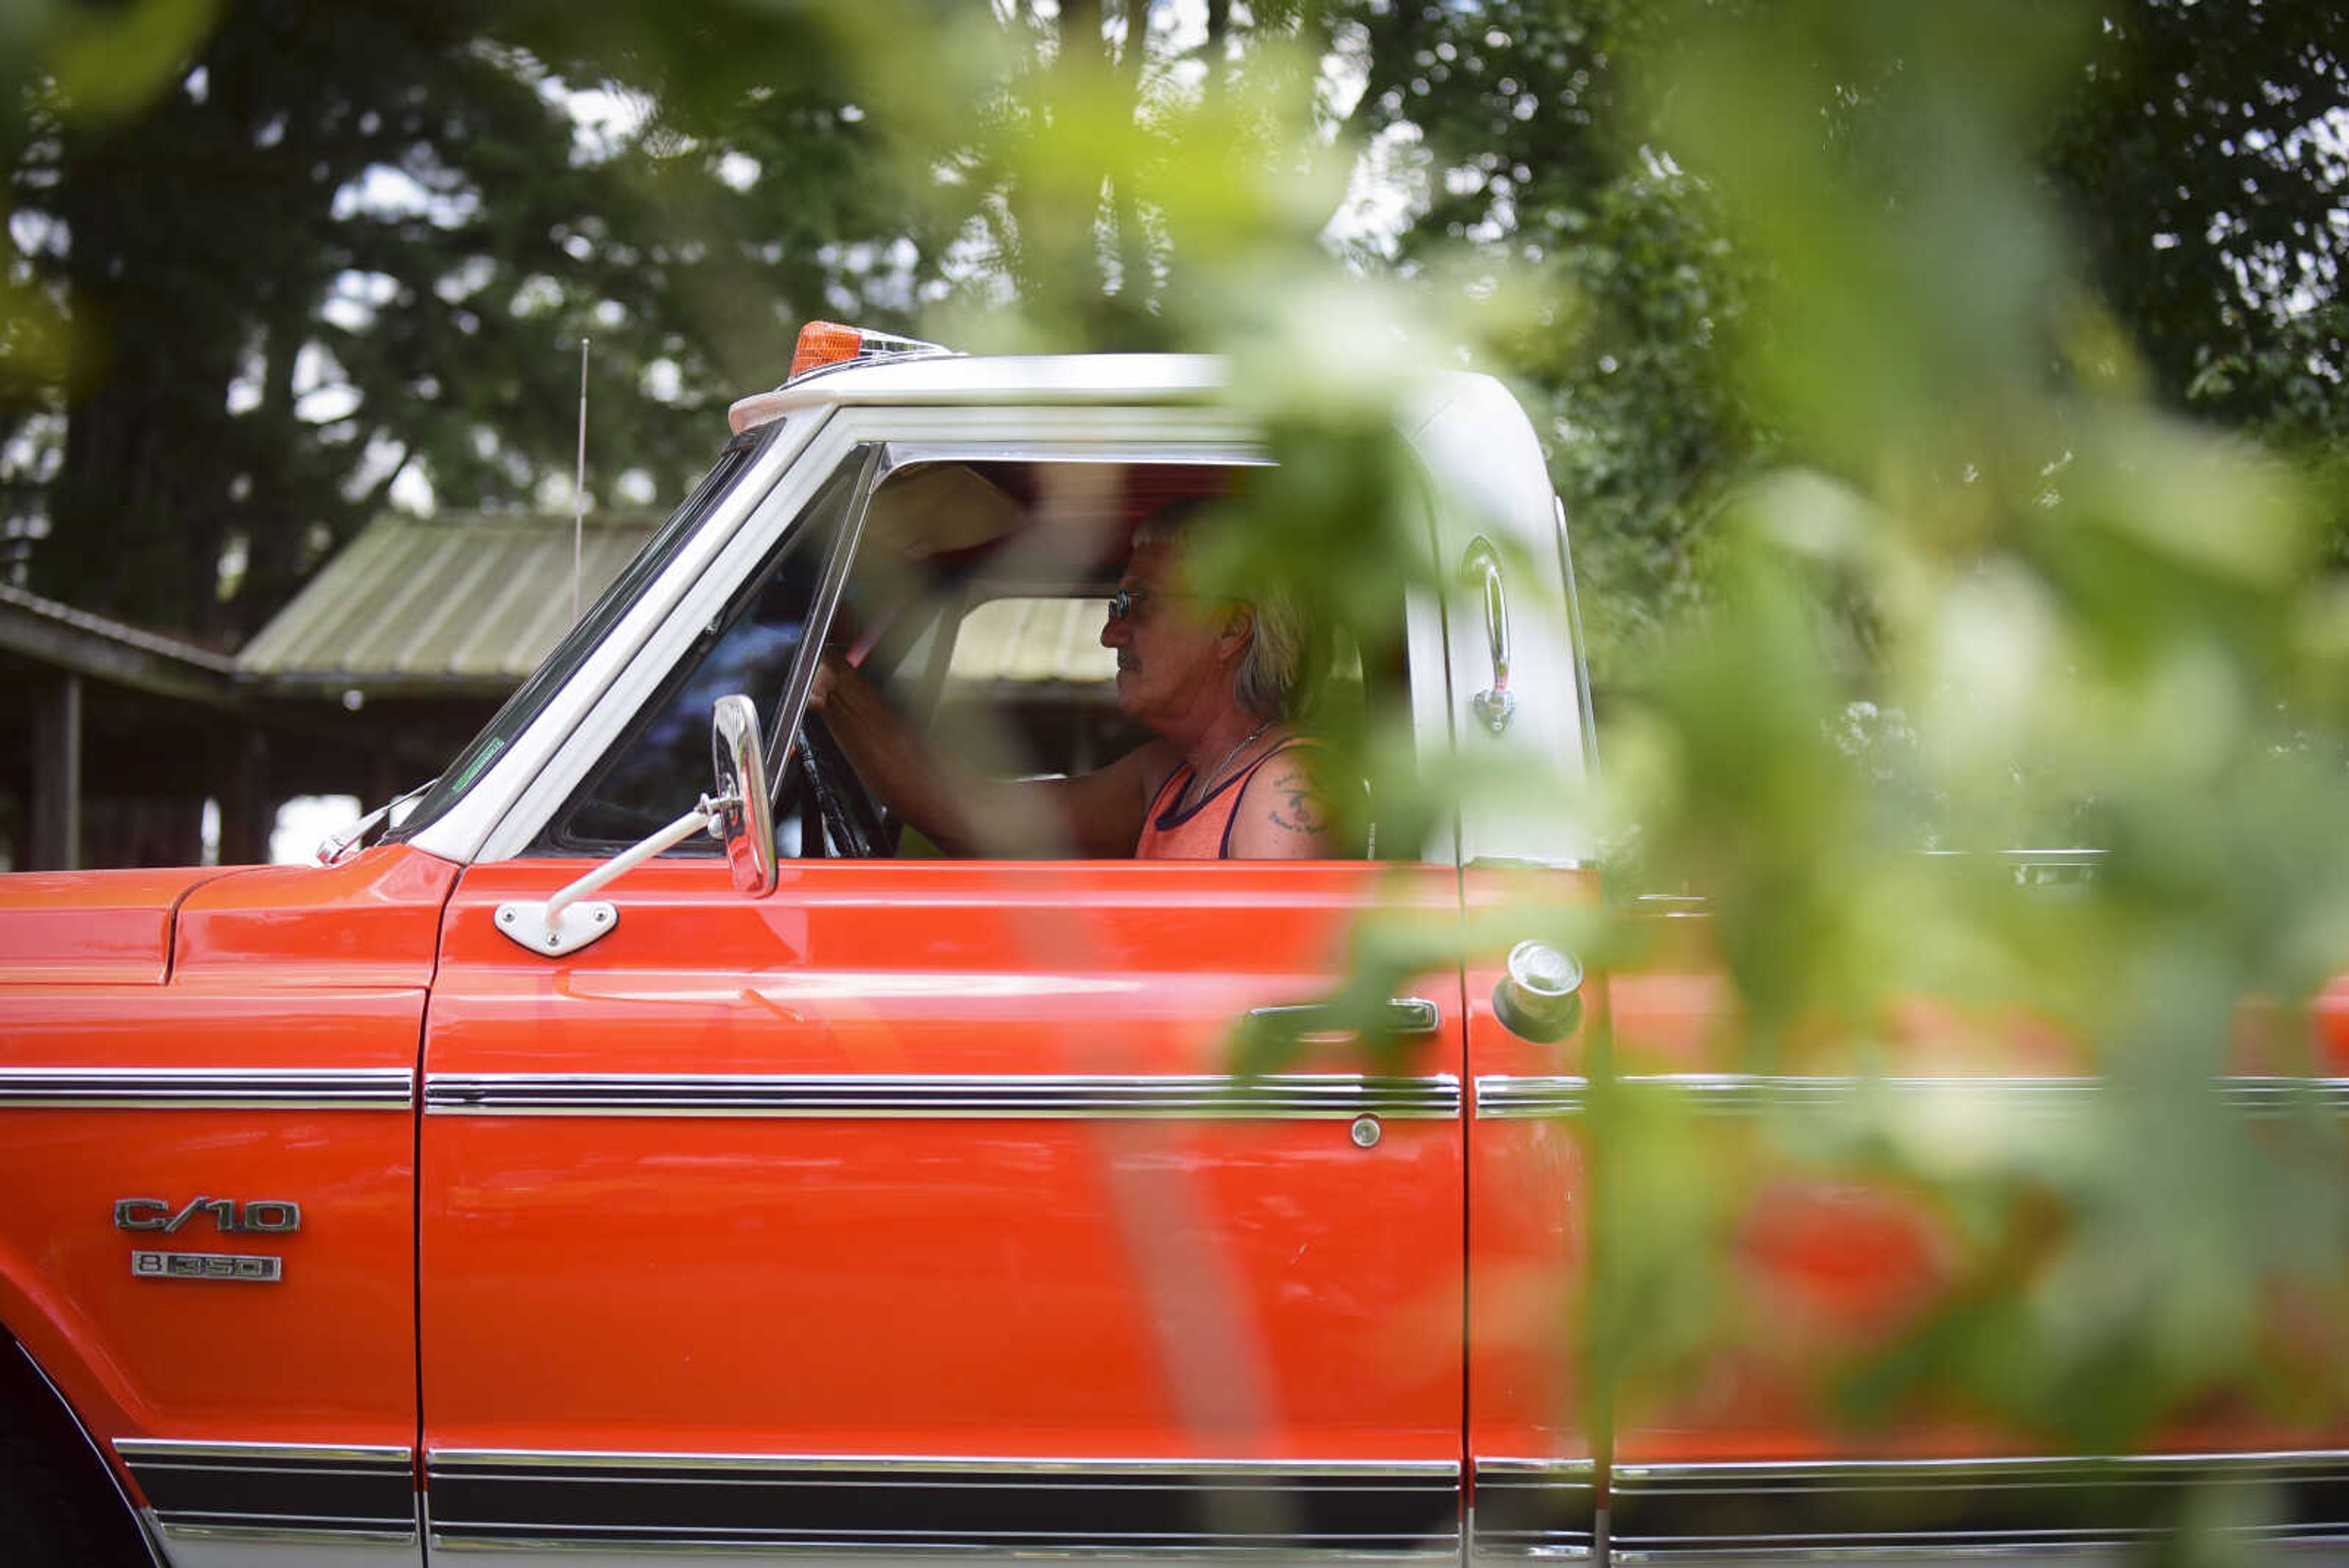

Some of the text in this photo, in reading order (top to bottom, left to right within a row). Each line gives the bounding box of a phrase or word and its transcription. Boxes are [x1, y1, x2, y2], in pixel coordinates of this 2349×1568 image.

[114, 1196, 301, 1232] C/10
[139, 1255, 261, 1274] 8 350
